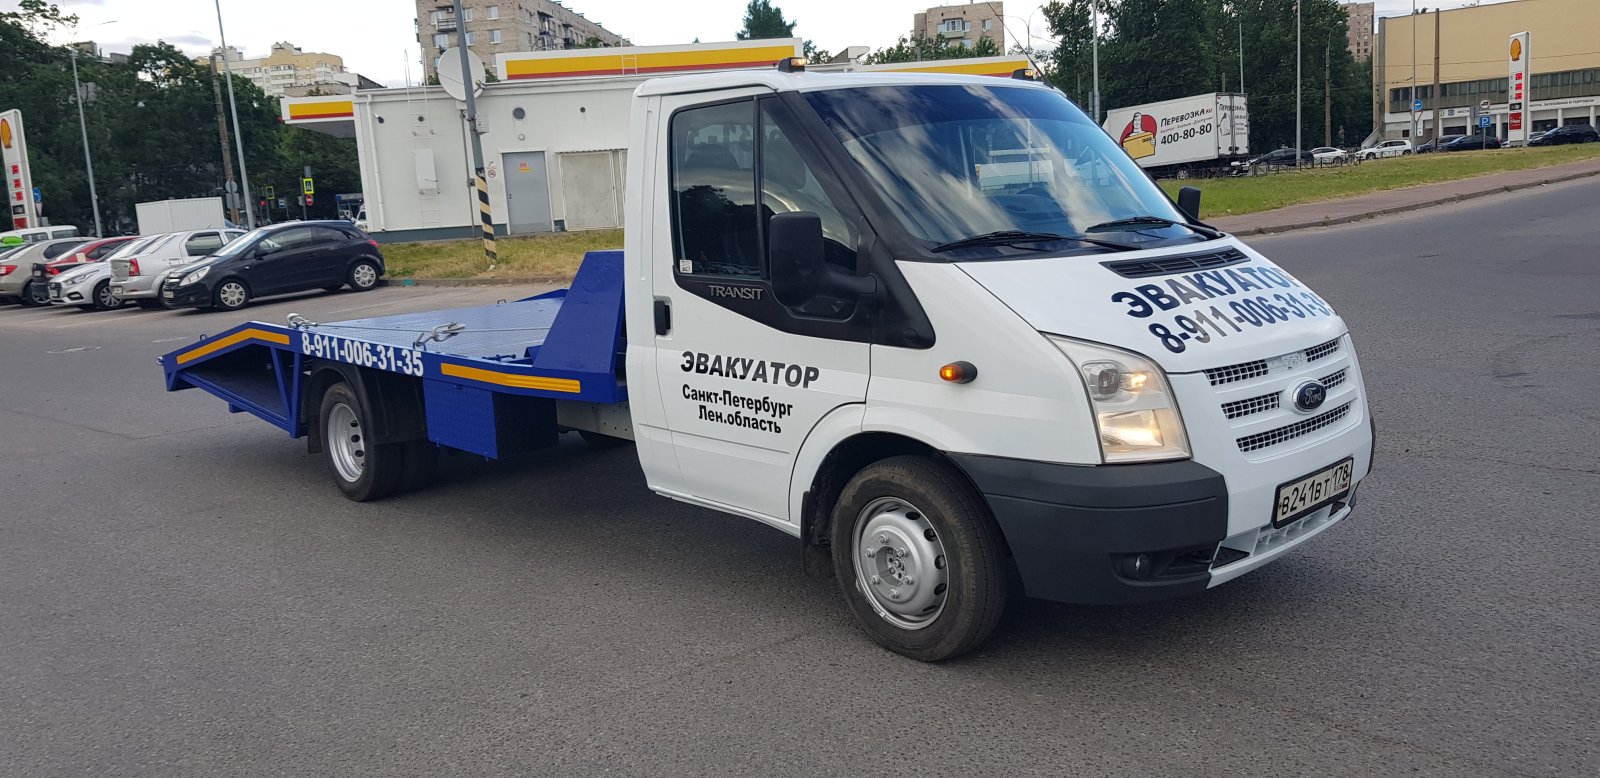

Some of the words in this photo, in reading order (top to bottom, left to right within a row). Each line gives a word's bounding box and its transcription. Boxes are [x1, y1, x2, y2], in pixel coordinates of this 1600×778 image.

[1160, 123, 1212, 145] 400-80-80
[708, 284, 764, 301] TRANSIT
[301, 332, 424, 377] 8-911-006-31-35
[680, 350, 820, 389] ЭВАКУАТОР
[682, 384, 793, 419] Санкт-Петербург
[1304, 386, 1322, 405] Ford
[698, 405, 782, 434] Лен.область
